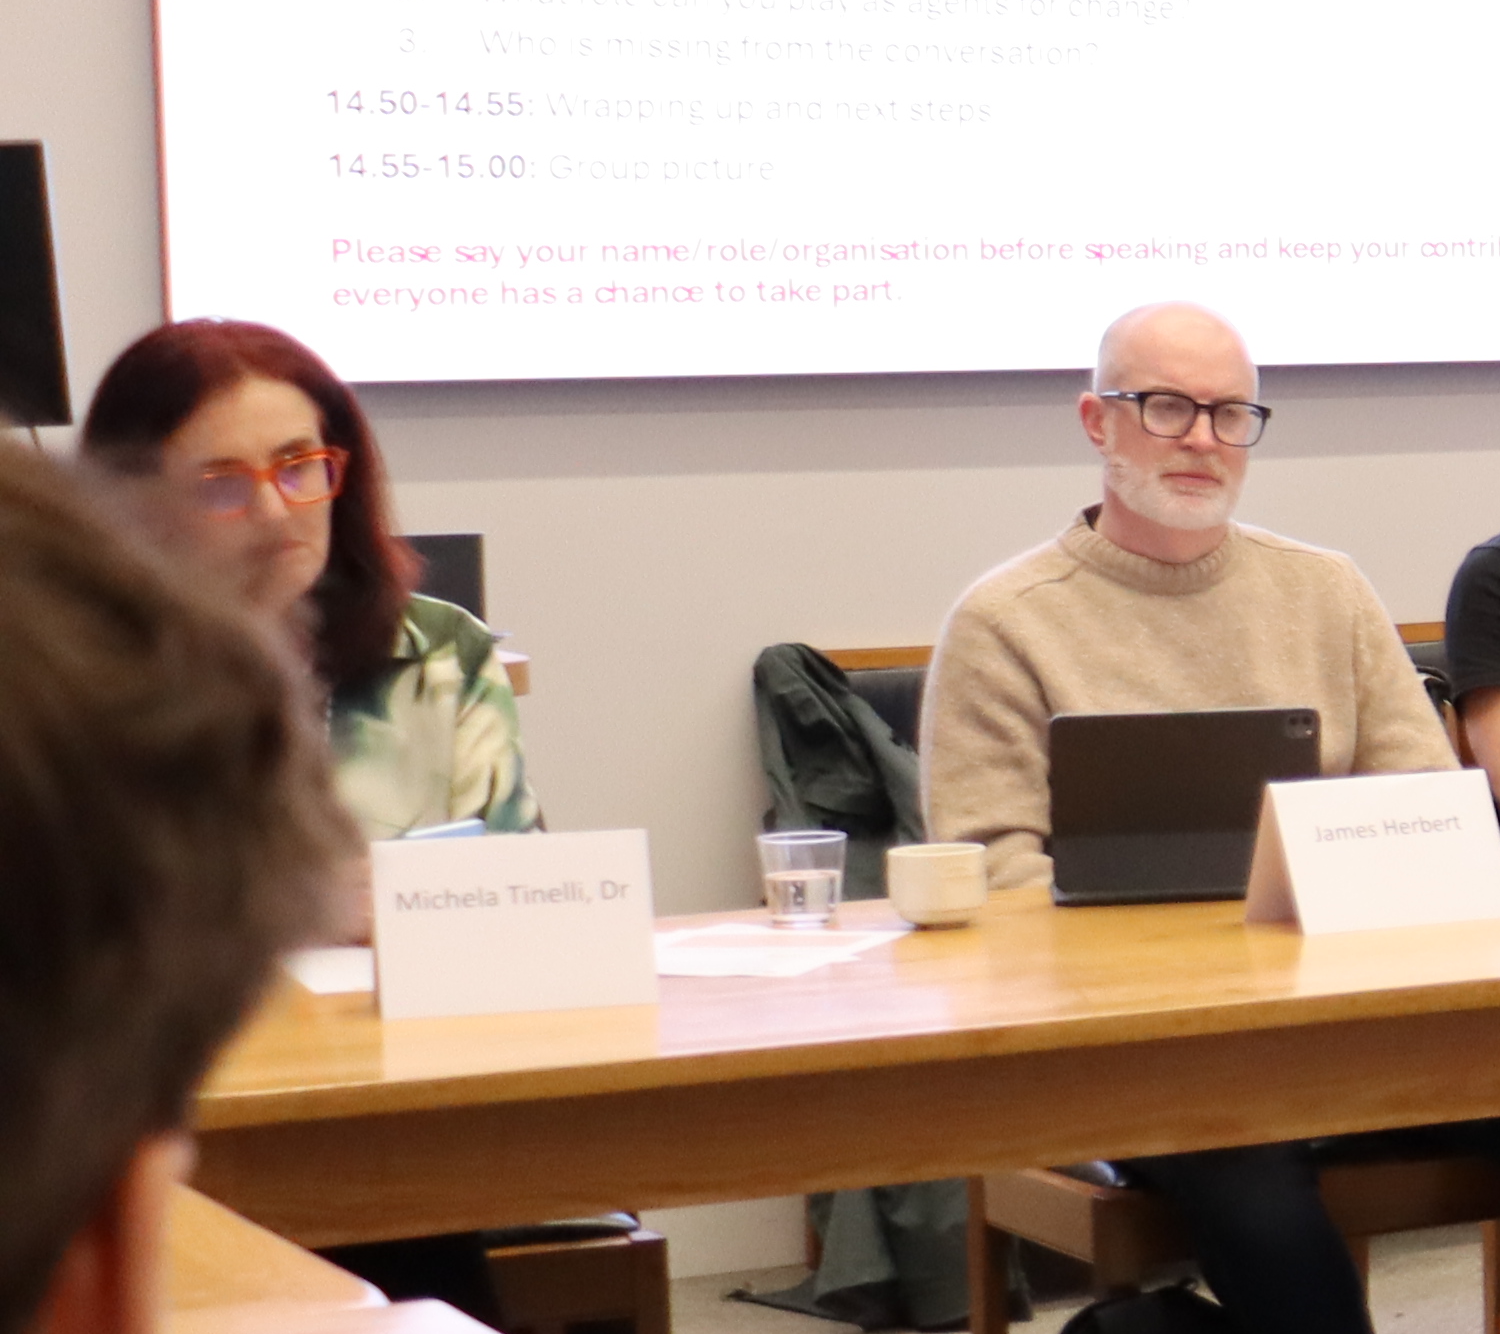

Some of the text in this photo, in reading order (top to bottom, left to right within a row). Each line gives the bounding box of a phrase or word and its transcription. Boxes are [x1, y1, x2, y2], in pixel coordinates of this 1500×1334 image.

[325, 88, 534, 118] 14.50-14.55:
[328, 152, 536, 180] 14.55-15.00:
[331, 238, 442, 264] Please
[453, 244, 504, 270] say
[516, 244, 588, 270] your
[979, 237, 1074, 261] before
[1084, 237, 1209, 266] speaking
[1217, 237, 1268, 259] and
[1278, 237, 1342, 263] keep
[1350, 241, 1408, 264] your
[332, 279, 903, 312] everyone has a chance to take part.
[1314, 815, 1463, 843] James Herbert
[395, 878, 630, 911] Michela Tinelli, Dr
